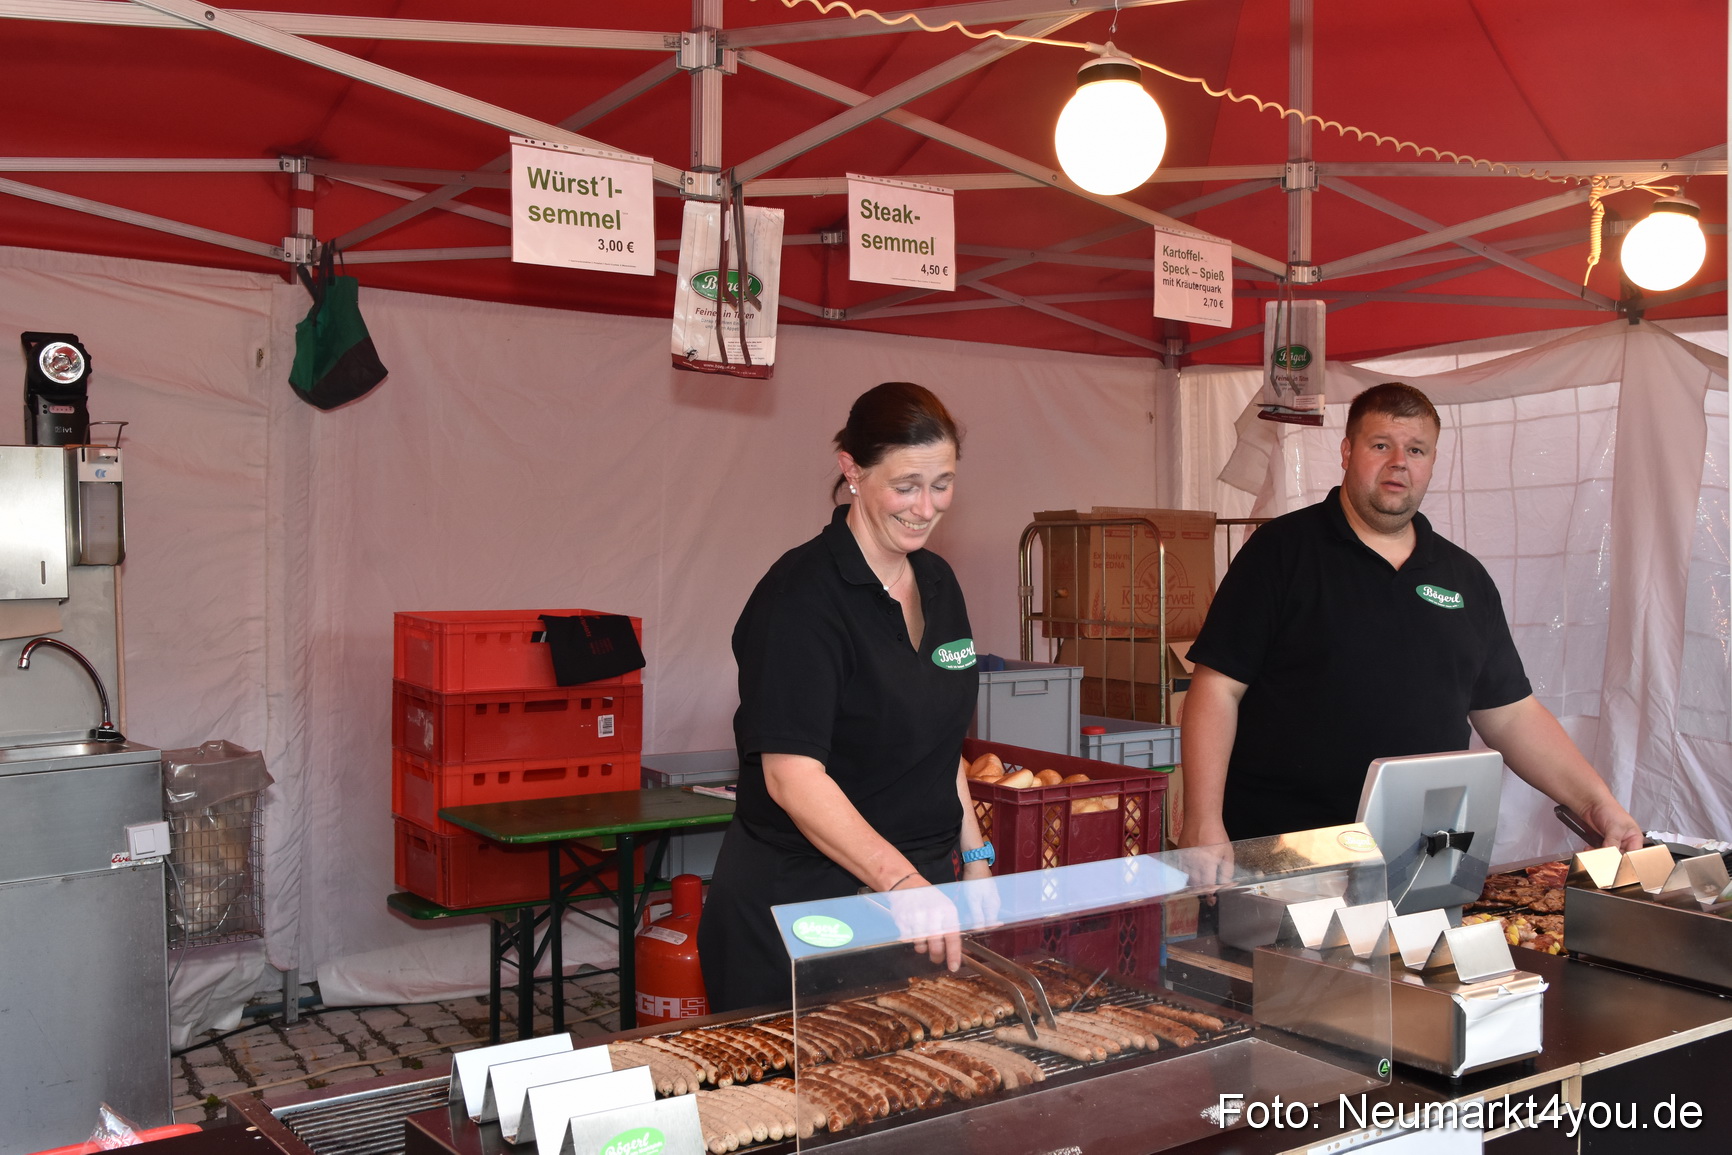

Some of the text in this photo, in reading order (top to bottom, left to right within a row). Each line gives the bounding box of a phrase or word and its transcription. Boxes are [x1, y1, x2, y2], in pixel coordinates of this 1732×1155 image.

[528, 205, 621, 230] semmel
[860, 198, 921, 224] Steak-
[598, 239, 634, 253] 3,00 €
[861, 233, 935, 256] semmel
[1163, 245, 1204, 262] Kartoffel-
[921, 264, 948, 276] 4,50 €
[1162, 261, 1190, 276] Speck
[1200, 267, 1225, 281] Spieß
[1162, 277, 1222, 294] mit Kräuterquark
[1203, 296, 1224, 309] 2,70 €
[723, 309, 732, 318] in
[1423, 586, 1460, 603] Bögerl
[938, 640, 976, 665] Bögerl
